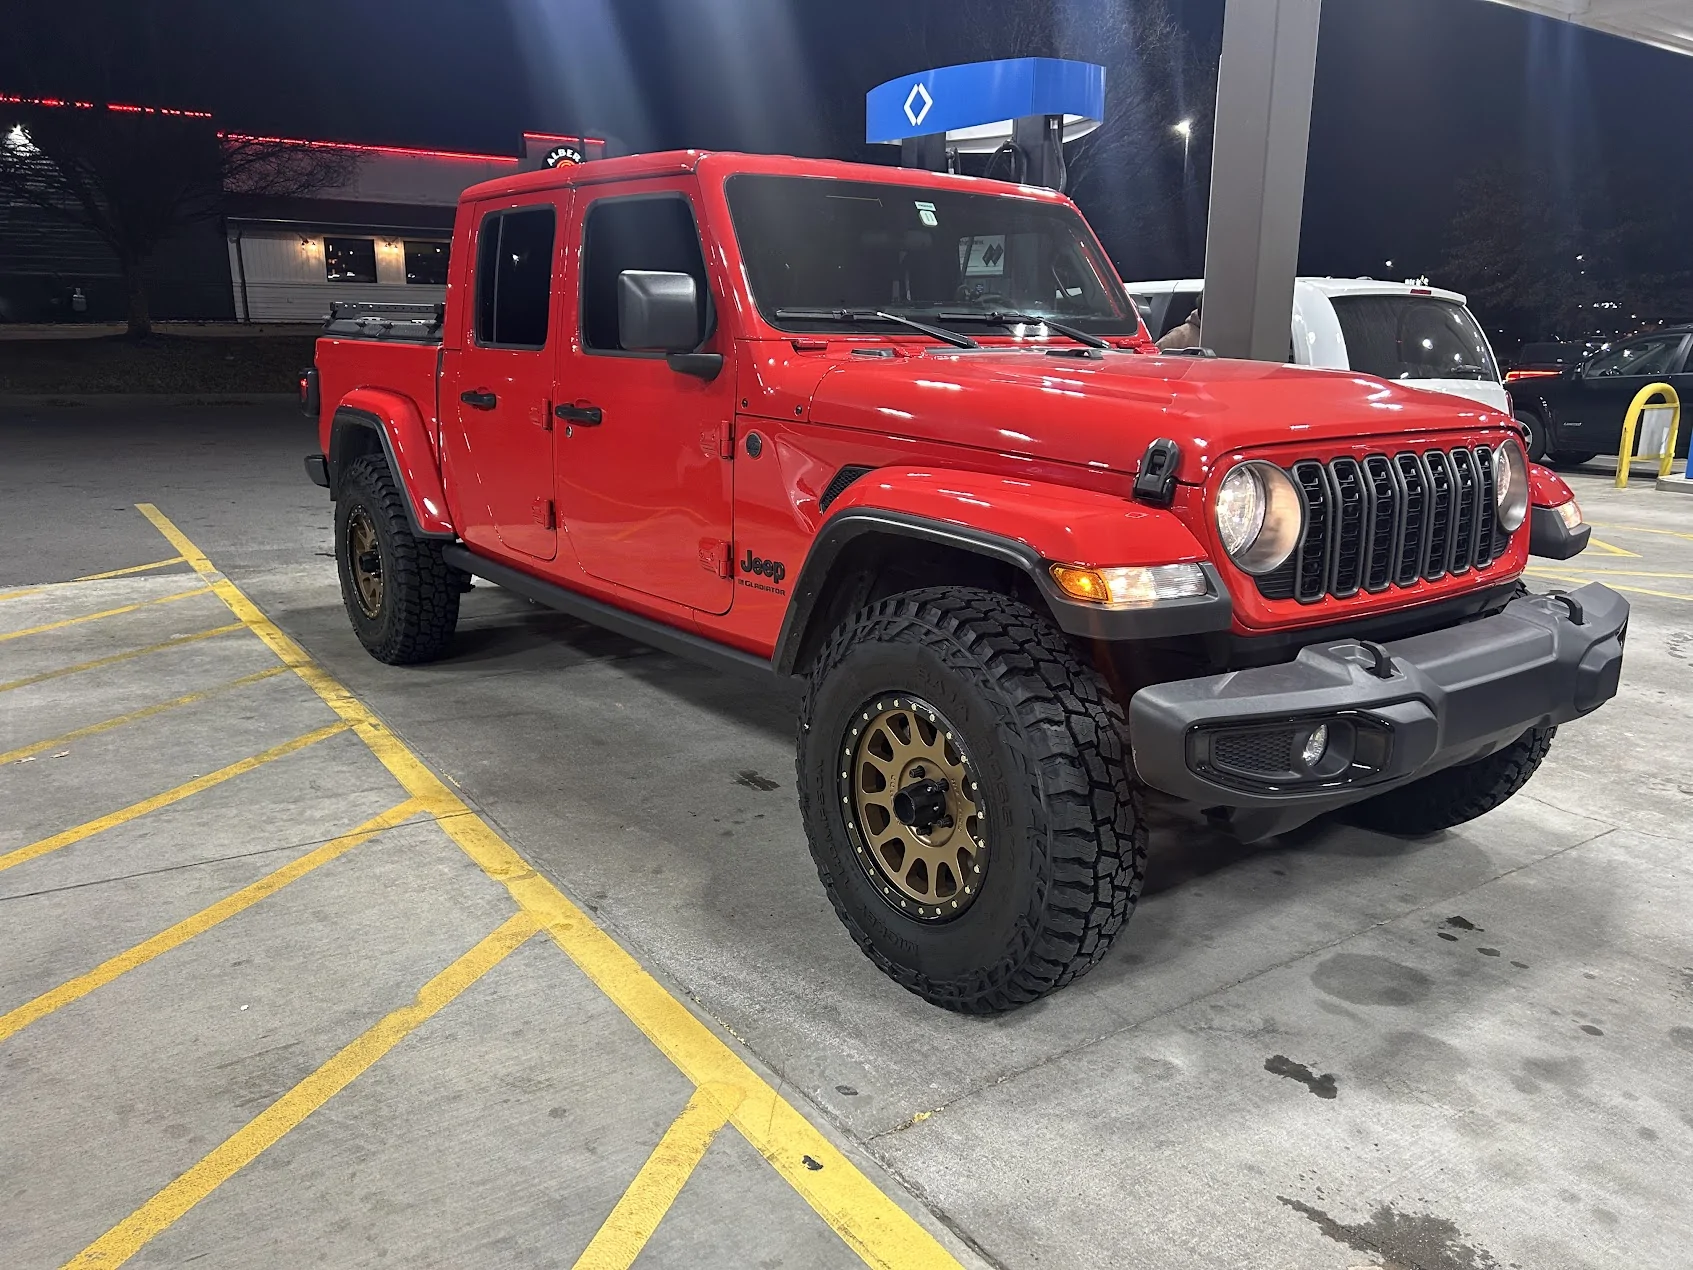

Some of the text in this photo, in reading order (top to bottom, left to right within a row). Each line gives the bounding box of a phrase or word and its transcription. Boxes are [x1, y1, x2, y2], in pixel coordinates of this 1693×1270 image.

[546, 148, 585, 166] ALBER
[740, 550, 785, 584] Jeep
[744, 580, 786, 596] GLADIATOR
